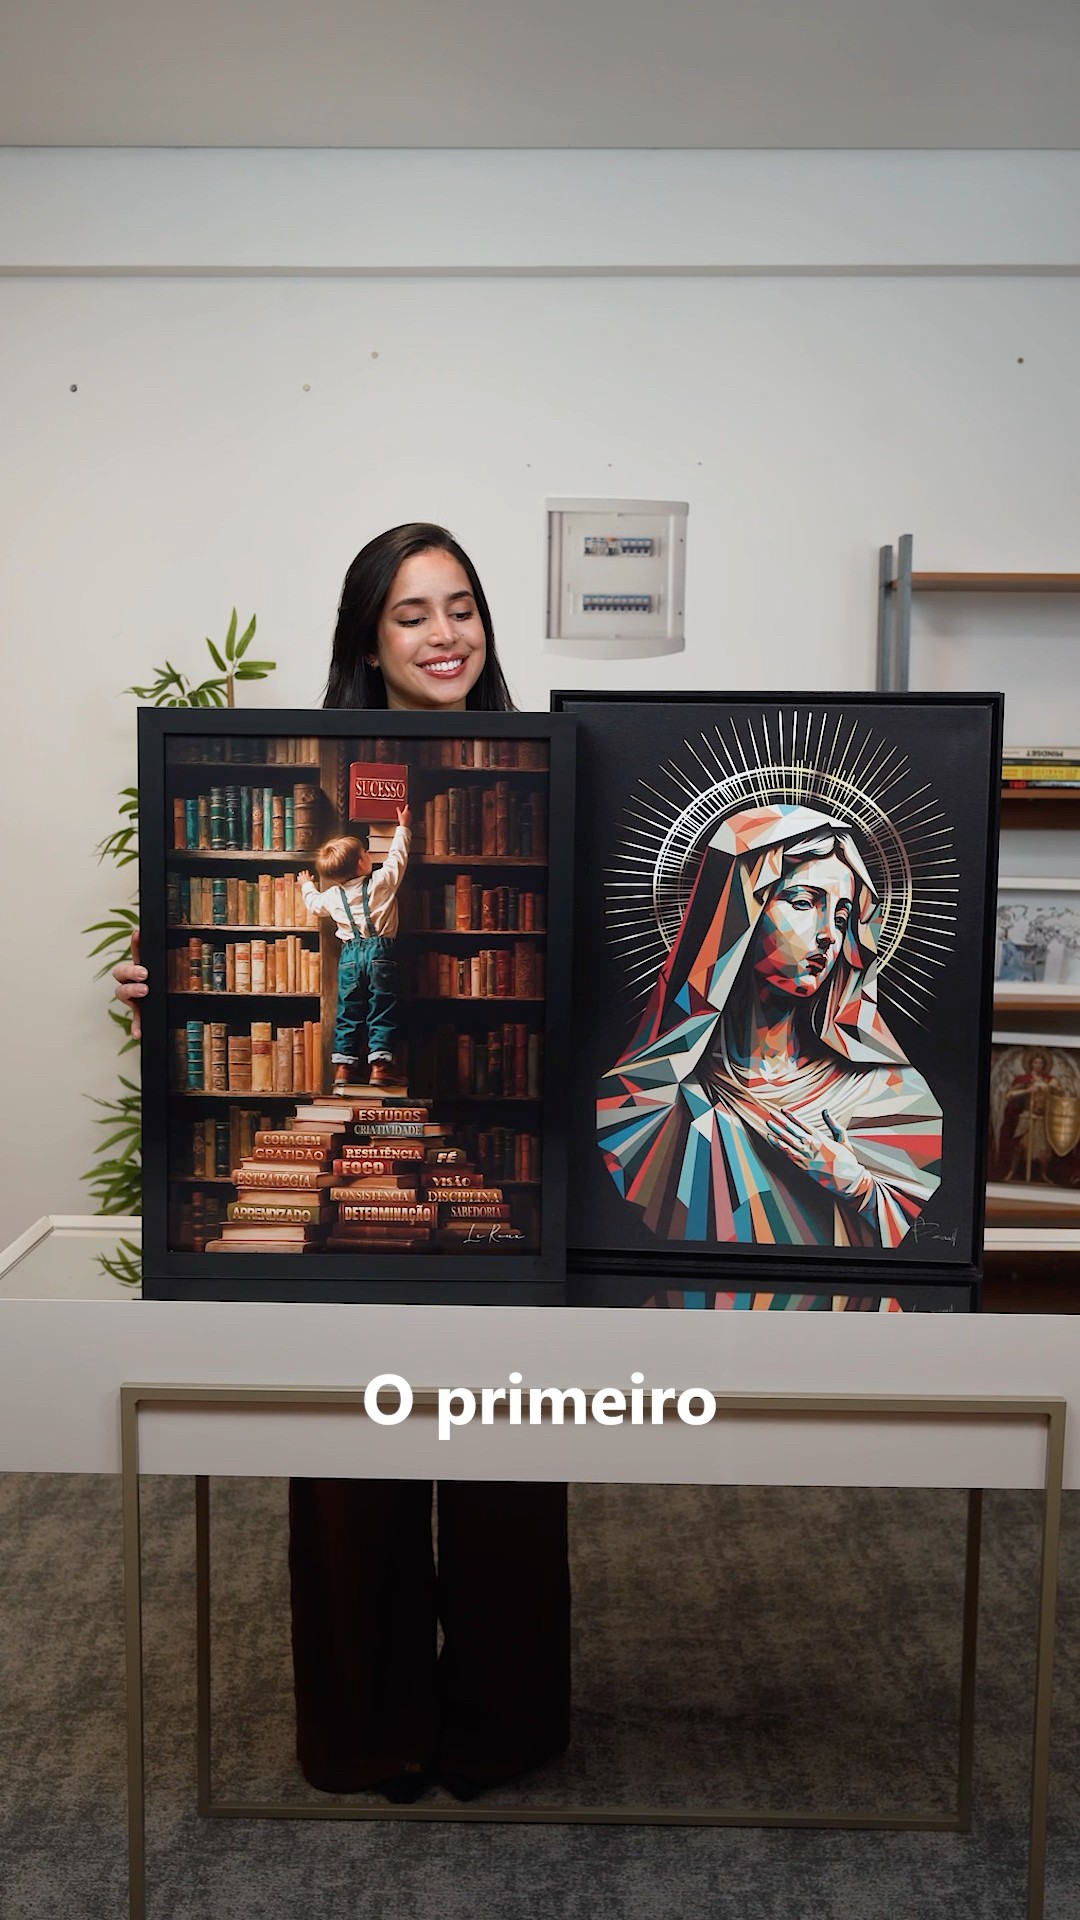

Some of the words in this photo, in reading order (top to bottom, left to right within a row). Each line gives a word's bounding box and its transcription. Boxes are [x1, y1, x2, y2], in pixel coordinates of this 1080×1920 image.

[355, 780, 405, 798] SUCESSO
[358, 1109, 421, 1122] ESTUDOS
[354, 1123, 422, 1136] CRIATIVIDADE
[263, 1134, 321, 1146] CORAGEM
[255, 1148, 324, 1160] GRATIDÃO
[345, 1147, 422, 1159] RESILIÊNCIA
[436, 1151, 458, 1163] FÉ
[342, 1161, 385, 1175] FOCO
[237, 1171, 311, 1187] ESTRATÉGIA
[432, 1174, 471, 1187] VISÃO
[427, 1190, 500, 1203] DISCIPLINA
[232, 1206, 311, 1222] APRENDIZADO
[344, 1204, 431, 1225] DETERMINAÇÃO
[450, 1206, 502, 1218] SABEDORIA
